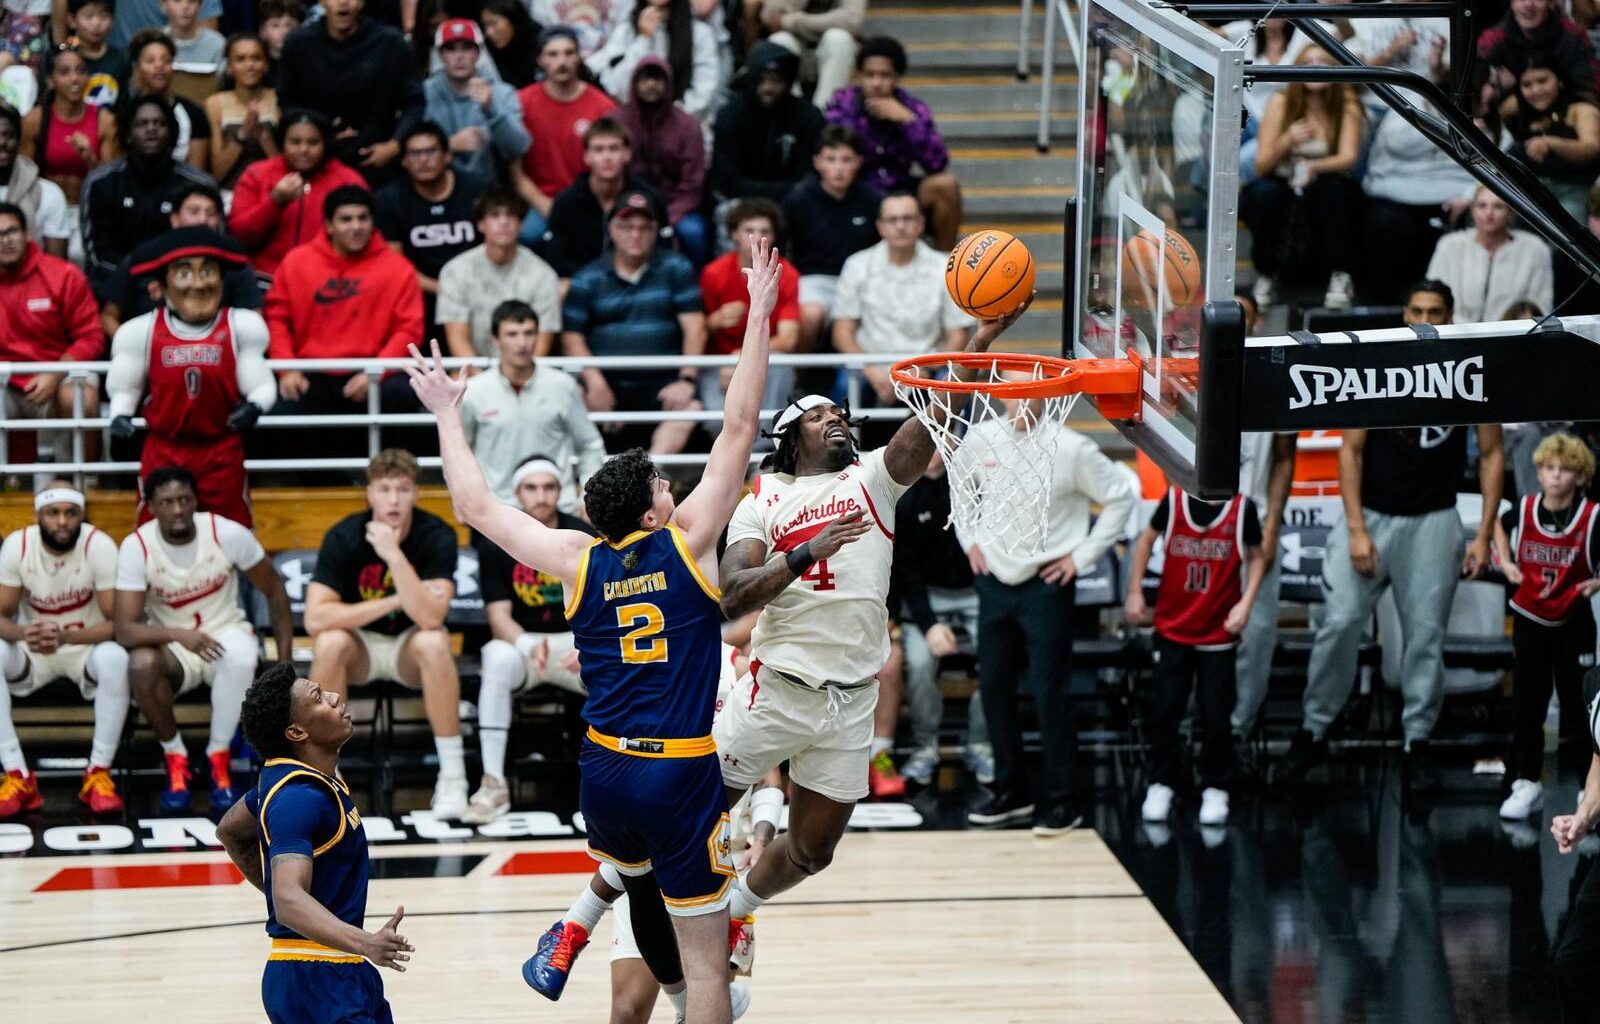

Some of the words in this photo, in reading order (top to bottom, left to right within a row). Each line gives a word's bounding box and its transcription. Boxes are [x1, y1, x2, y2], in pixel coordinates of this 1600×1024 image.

[410, 220, 476, 248] CSUN
[966, 235, 999, 272] NCAA
[1288, 354, 1484, 410] SPALDING
[770, 494, 861, 543] Northridge
[603, 571, 667, 601] CARRINGTON
[1184, 562, 1211, 594] 11
[616, 602, 668, 664] 2
